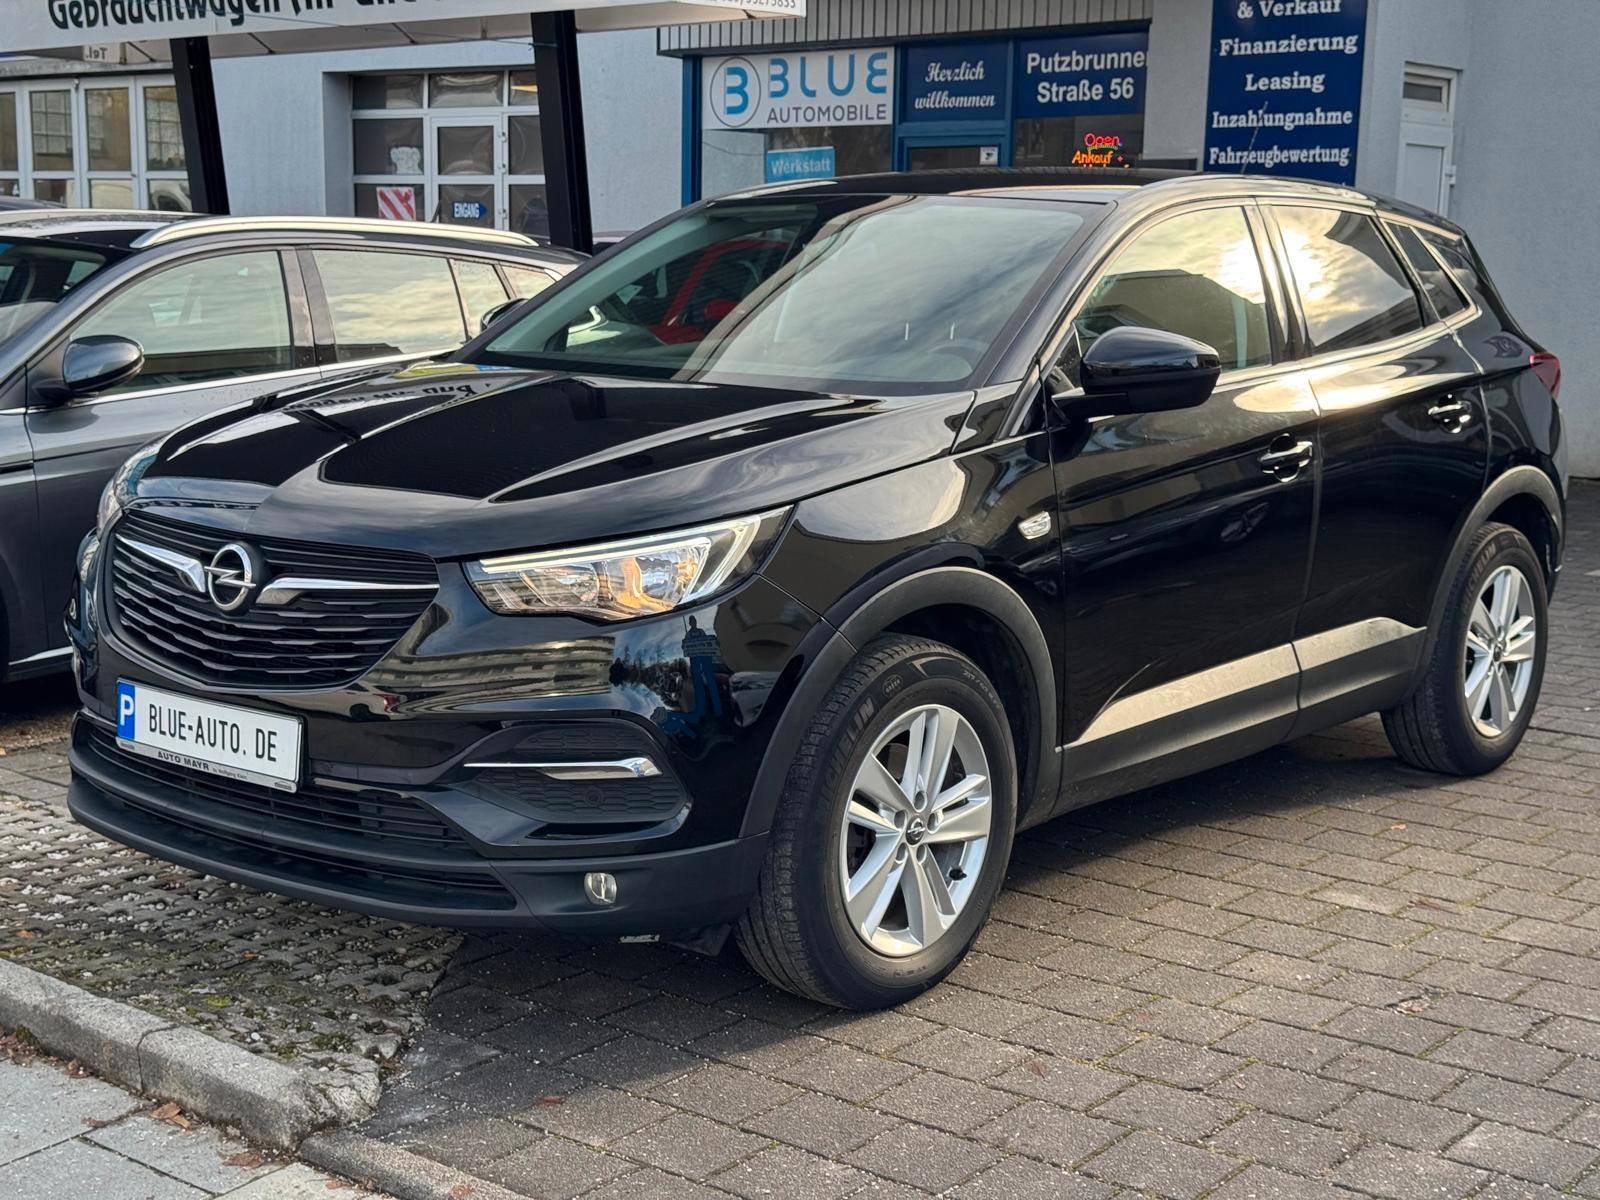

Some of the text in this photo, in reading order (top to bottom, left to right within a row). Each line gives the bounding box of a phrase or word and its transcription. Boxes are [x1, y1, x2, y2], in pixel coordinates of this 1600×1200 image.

[1237, 0, 1342, 19] & Verkauf
[1219, 34, 1359, 56] Finanzierung
[768, 52, 888, 98] BLUE
[925, 60, 985, 83] Herzlich
[1245, 71, 1326, 93] Leasing
[914, 91, 995, 109] willkommen
[1037, 77, 1135, 104] Straße 56
[767, 103, 887, 124] AUTOMOBILE
[1211, 107, 1353, 131] Inzahlungnahme
[1084, 133, 1121, 146] Open
[771, 157, 831, 177] Werkstatt
[1071, 149, 1115, 164] Ankauf
[1208, 145, 1350, 168] Fahrzeugbewertung
[453, 202, 480, 218] EINGANG
[120, 694, 135, 726] P
[157, 750, 182, 764] AUTO
[183, 757, 209, 771] MAYR
